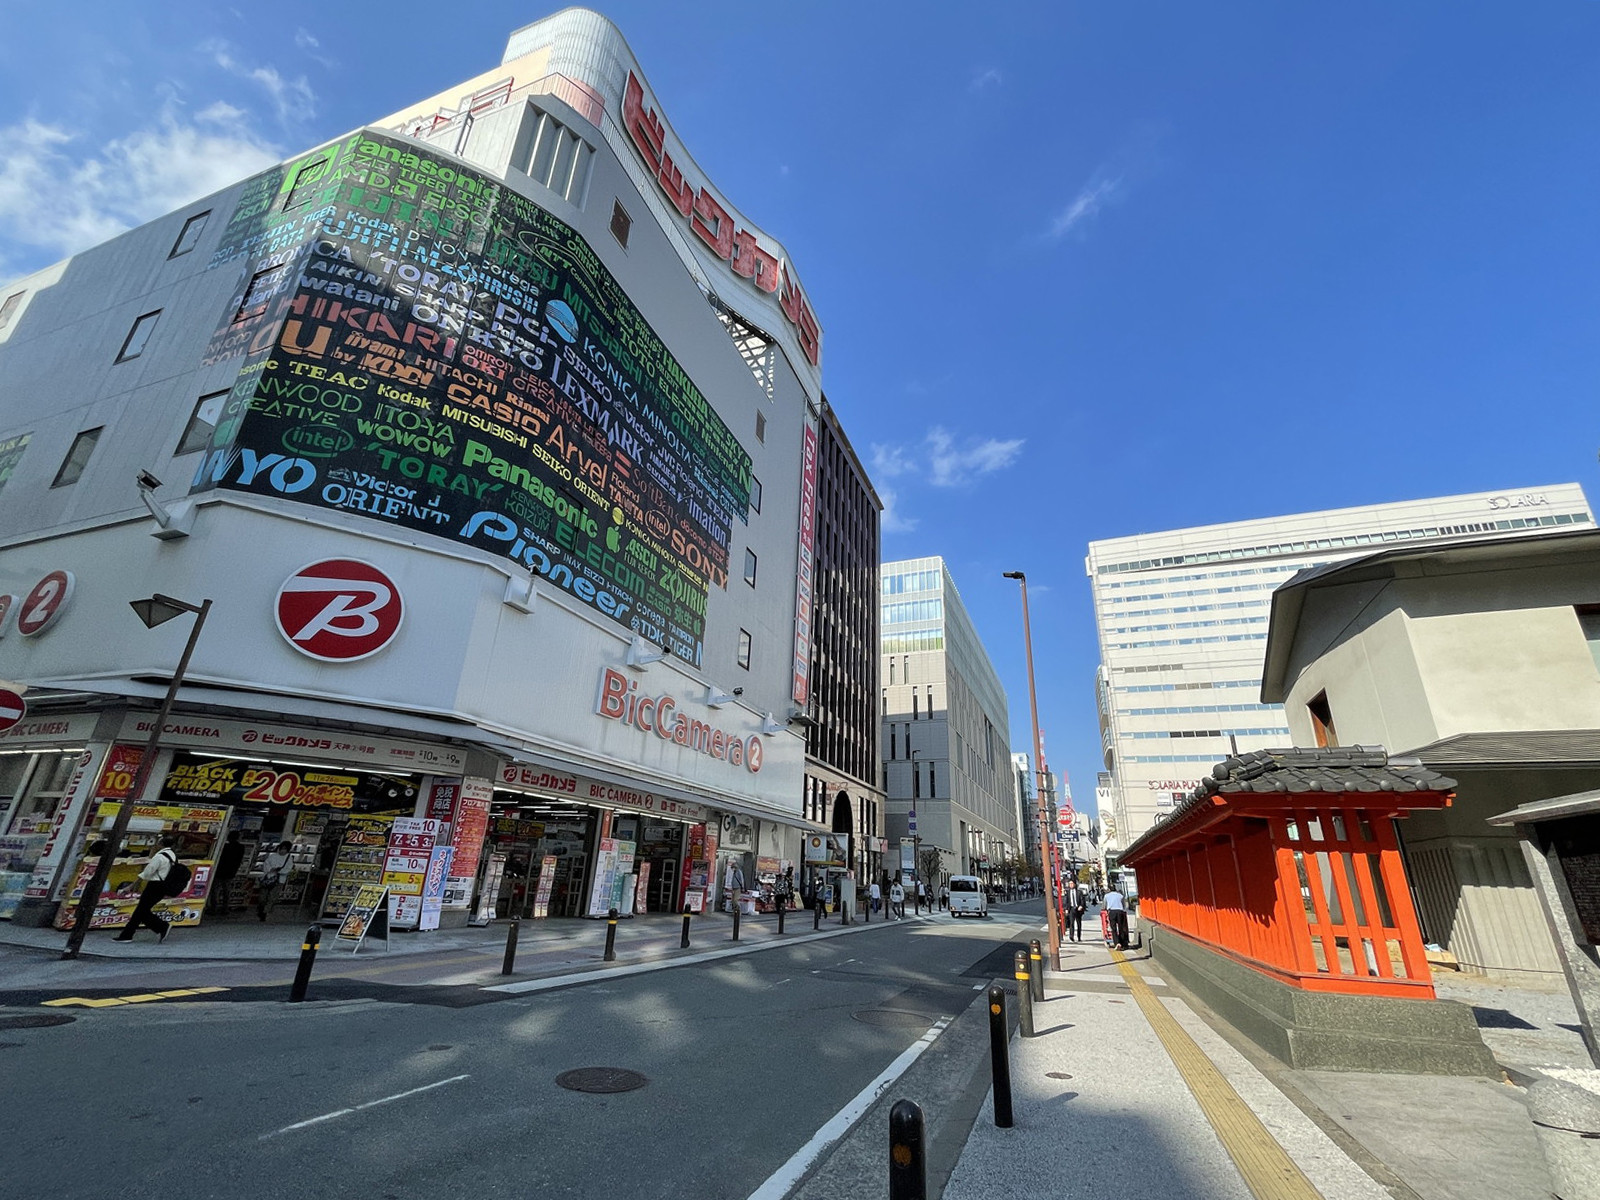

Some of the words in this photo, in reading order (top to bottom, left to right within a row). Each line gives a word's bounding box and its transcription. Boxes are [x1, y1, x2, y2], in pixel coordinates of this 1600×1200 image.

[349, 135, 501, 201] Panasonic
[399, 166, 448, 193] TIGER
[346, 210, 399, 234] Kodak
[621, 67, 820, 368] ビックカメラ
[540, 246, 573, 270] NTT
[482, 259, 540, 296] corega
[396, 283, 485, 321] SHARP
[275, 294, 457, 360] HIKARI
[411, 304, 543, 370] ONKYO
[562, 280, 643, 386] MITSUBISHI
[460, 353, 506, 382] OKI
[619, 326, 656, 378] TOTO
[289, 360, 371, 391] TEAC
[413, 355, 499, 396] HITACHI
[562, 345, 614, 403] SEIKO
[227, 396, 341, 428] CREATIVE
[233, 376, 363, 414] KENWOOD
[377, 382, 433, 411] Kodak
[446, 383, 541, 437] CASIO
[549, 353, 645, 469] LEXMARK
[583, 337, 639, 411] KONICA
[641, 404, 691, 469] MINOLTA
[292, 426, 343, 452] intel
[356, 417, 452, 458] WOWOW
[442, 404, 528, 449] MITSUBISHI
[625, 407, 656, 446] Victor
[531, 443, 572, 482] SEIKO
[545, 424, 609, 492] Arvel
[656, 446, 677, 470] JVC
[805, 435, 815, 477] Tax
[352, 471, 417, 499] Victor
[376, 449, 490, 499] TORAY
[462, 438, 599, 540] Panasonic
[611, 471, 640, 504] Roland
[321, 483, 450, 525] ORIENT
[573, 477, 611, 512] ORIENT
[608, 484, 644, 526] TANITA
[802, 477, 815, 531] Free
[522, 526, 562, 556] SHARP
[625, 519, 652, 547] KONICA
[459, 510, 631, 620] Pioneer
[563, 552, 582, 572] INAX
[625, 538, 658, 573] ASCII
[671, 528, 729, 593] SONY
[583, 565, 605, 588] EIZO
[636, 601, 667, 628] corega
[640, 619, 666, 647] TDK
[668, 635, 694, 663] TIGER
[28, 720, 70, 737] CAMERA
[162, 723, 221, 738] CAMERA
[596, 667, 744, 767] BicCamera
[262, 733, 332, 750] ビックカメラ
[104, 772, 131, 791] 10
[166, 777, 238, 794] FRIDAY
[174, 764, 238, 781] BLACK
[520, 768, 577, 793] ビックカメラ
[1148, 780, 1182, 791] SOLARIA
[1182, 780, 1203, 790] PLAZ
[589, 784, 606, 799] BIC
[606, 788, 643, 807] CAMERA
[677, 805, 688, 815] Tax
